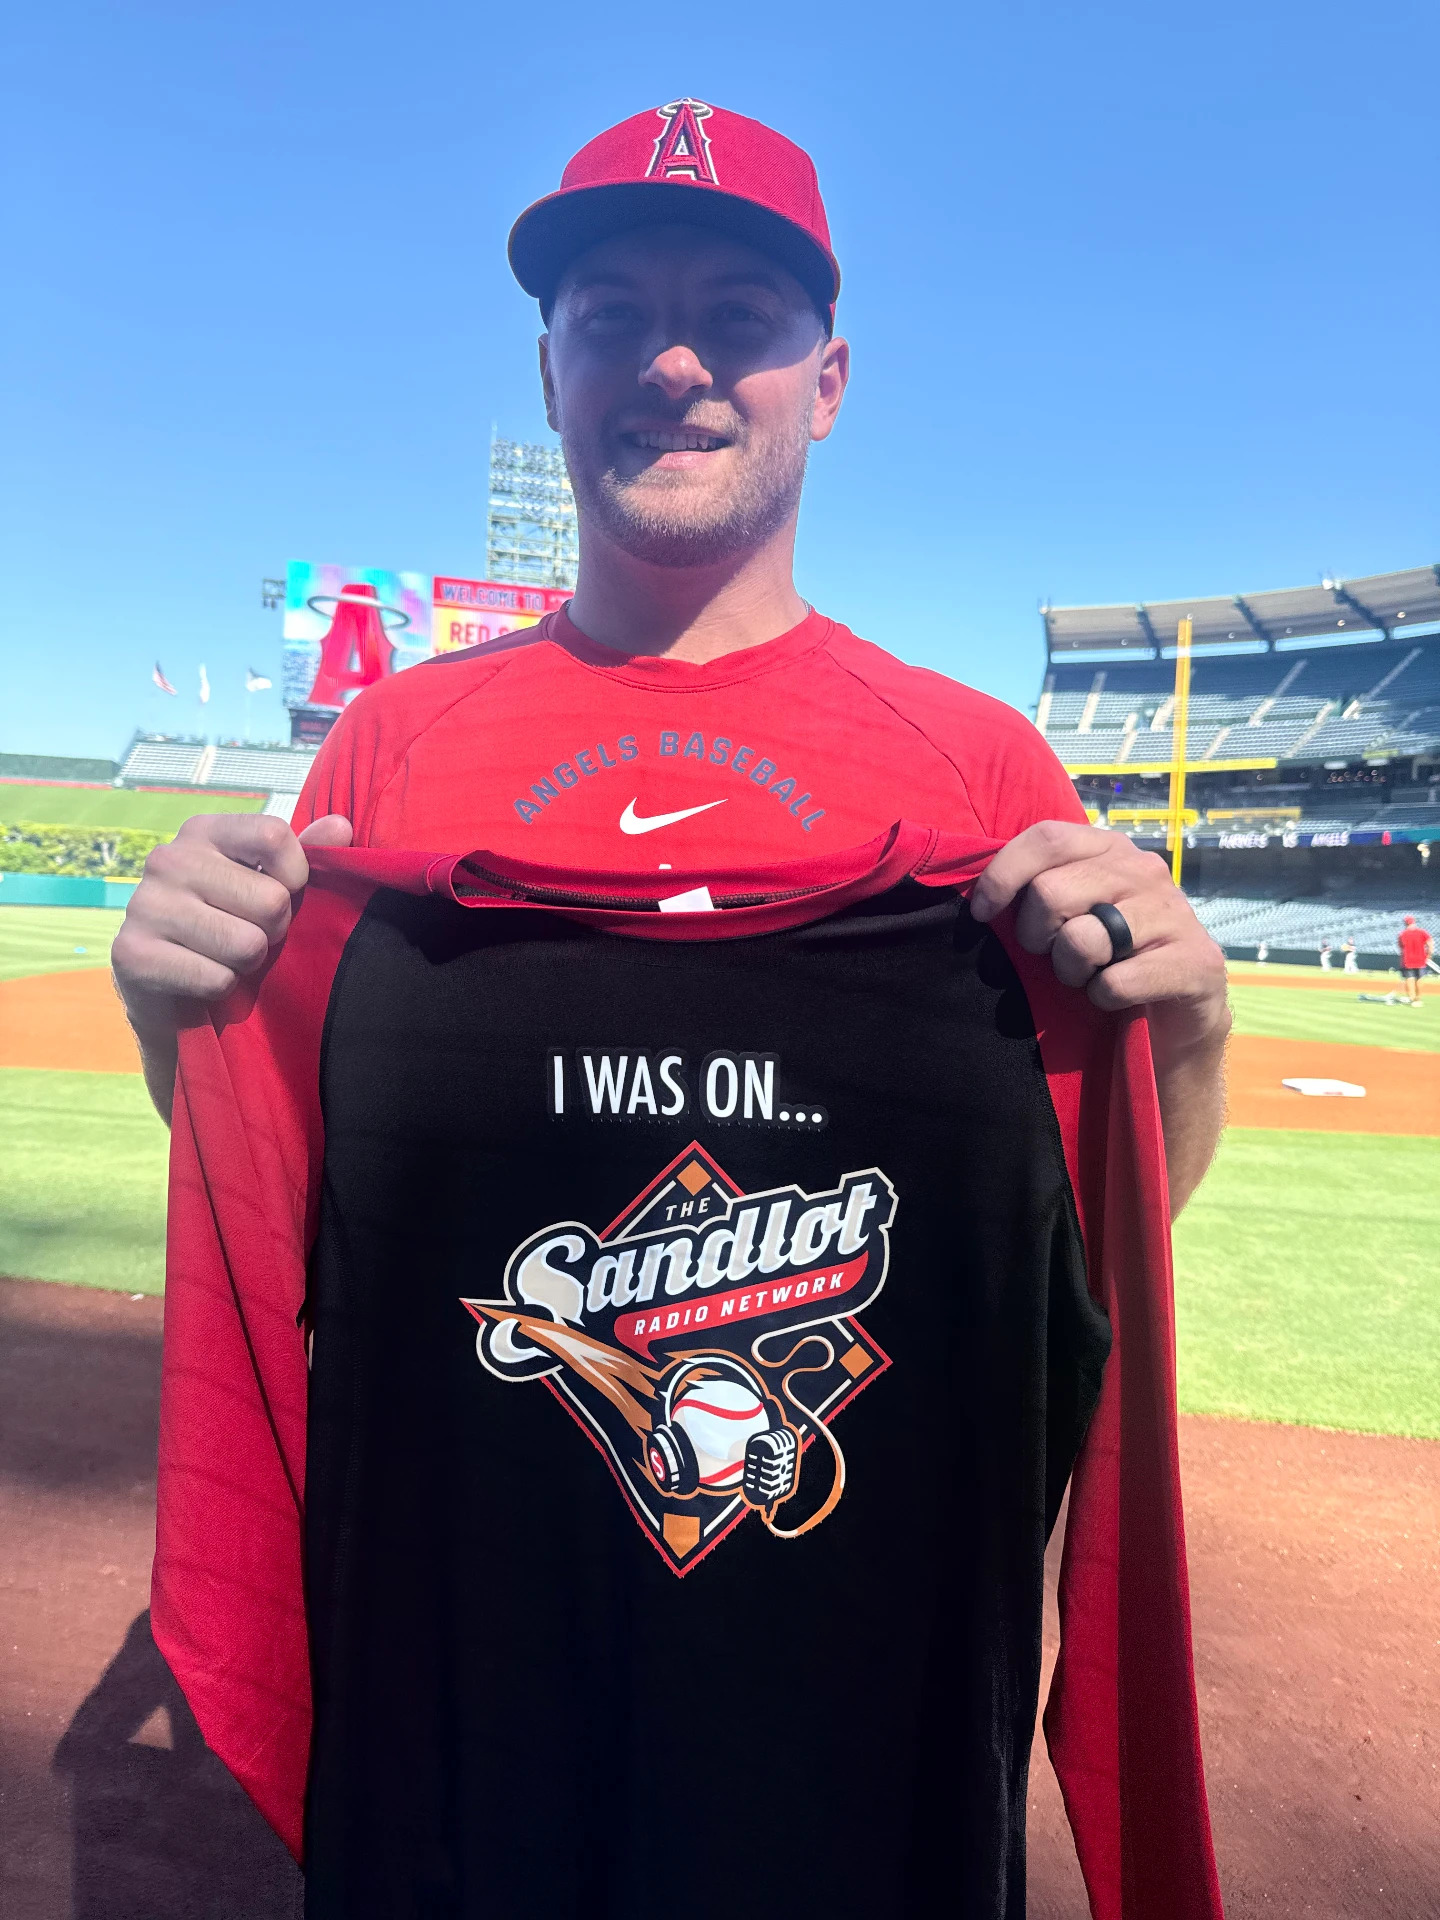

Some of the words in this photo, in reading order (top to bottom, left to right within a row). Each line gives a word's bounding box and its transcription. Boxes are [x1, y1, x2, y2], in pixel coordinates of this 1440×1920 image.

[645, 98, 720, 185] A
[442, 583, 516, 609] WELCOME
[524, 592, 543, 610] TO
[307, 583, 412, 706] A
[449, 621, 490, 645] RED
[513, 735, 639, 824] ANGELS
[659, 731, 826, 831] BASEBALL
[553, 1055, 564, 1114] I
[583, 1055, 685, 1116] WAS
[706, 1057, 823, 1123] ON...
[665, 1196, 711, 1221] THE
[489, 1182, 878, 1363] Sandlot
[633, 1304, 709, 1336] RADIO
[720, 1271, 845, 1317] NETWORK
[650, 1451, 664, 1477] S
